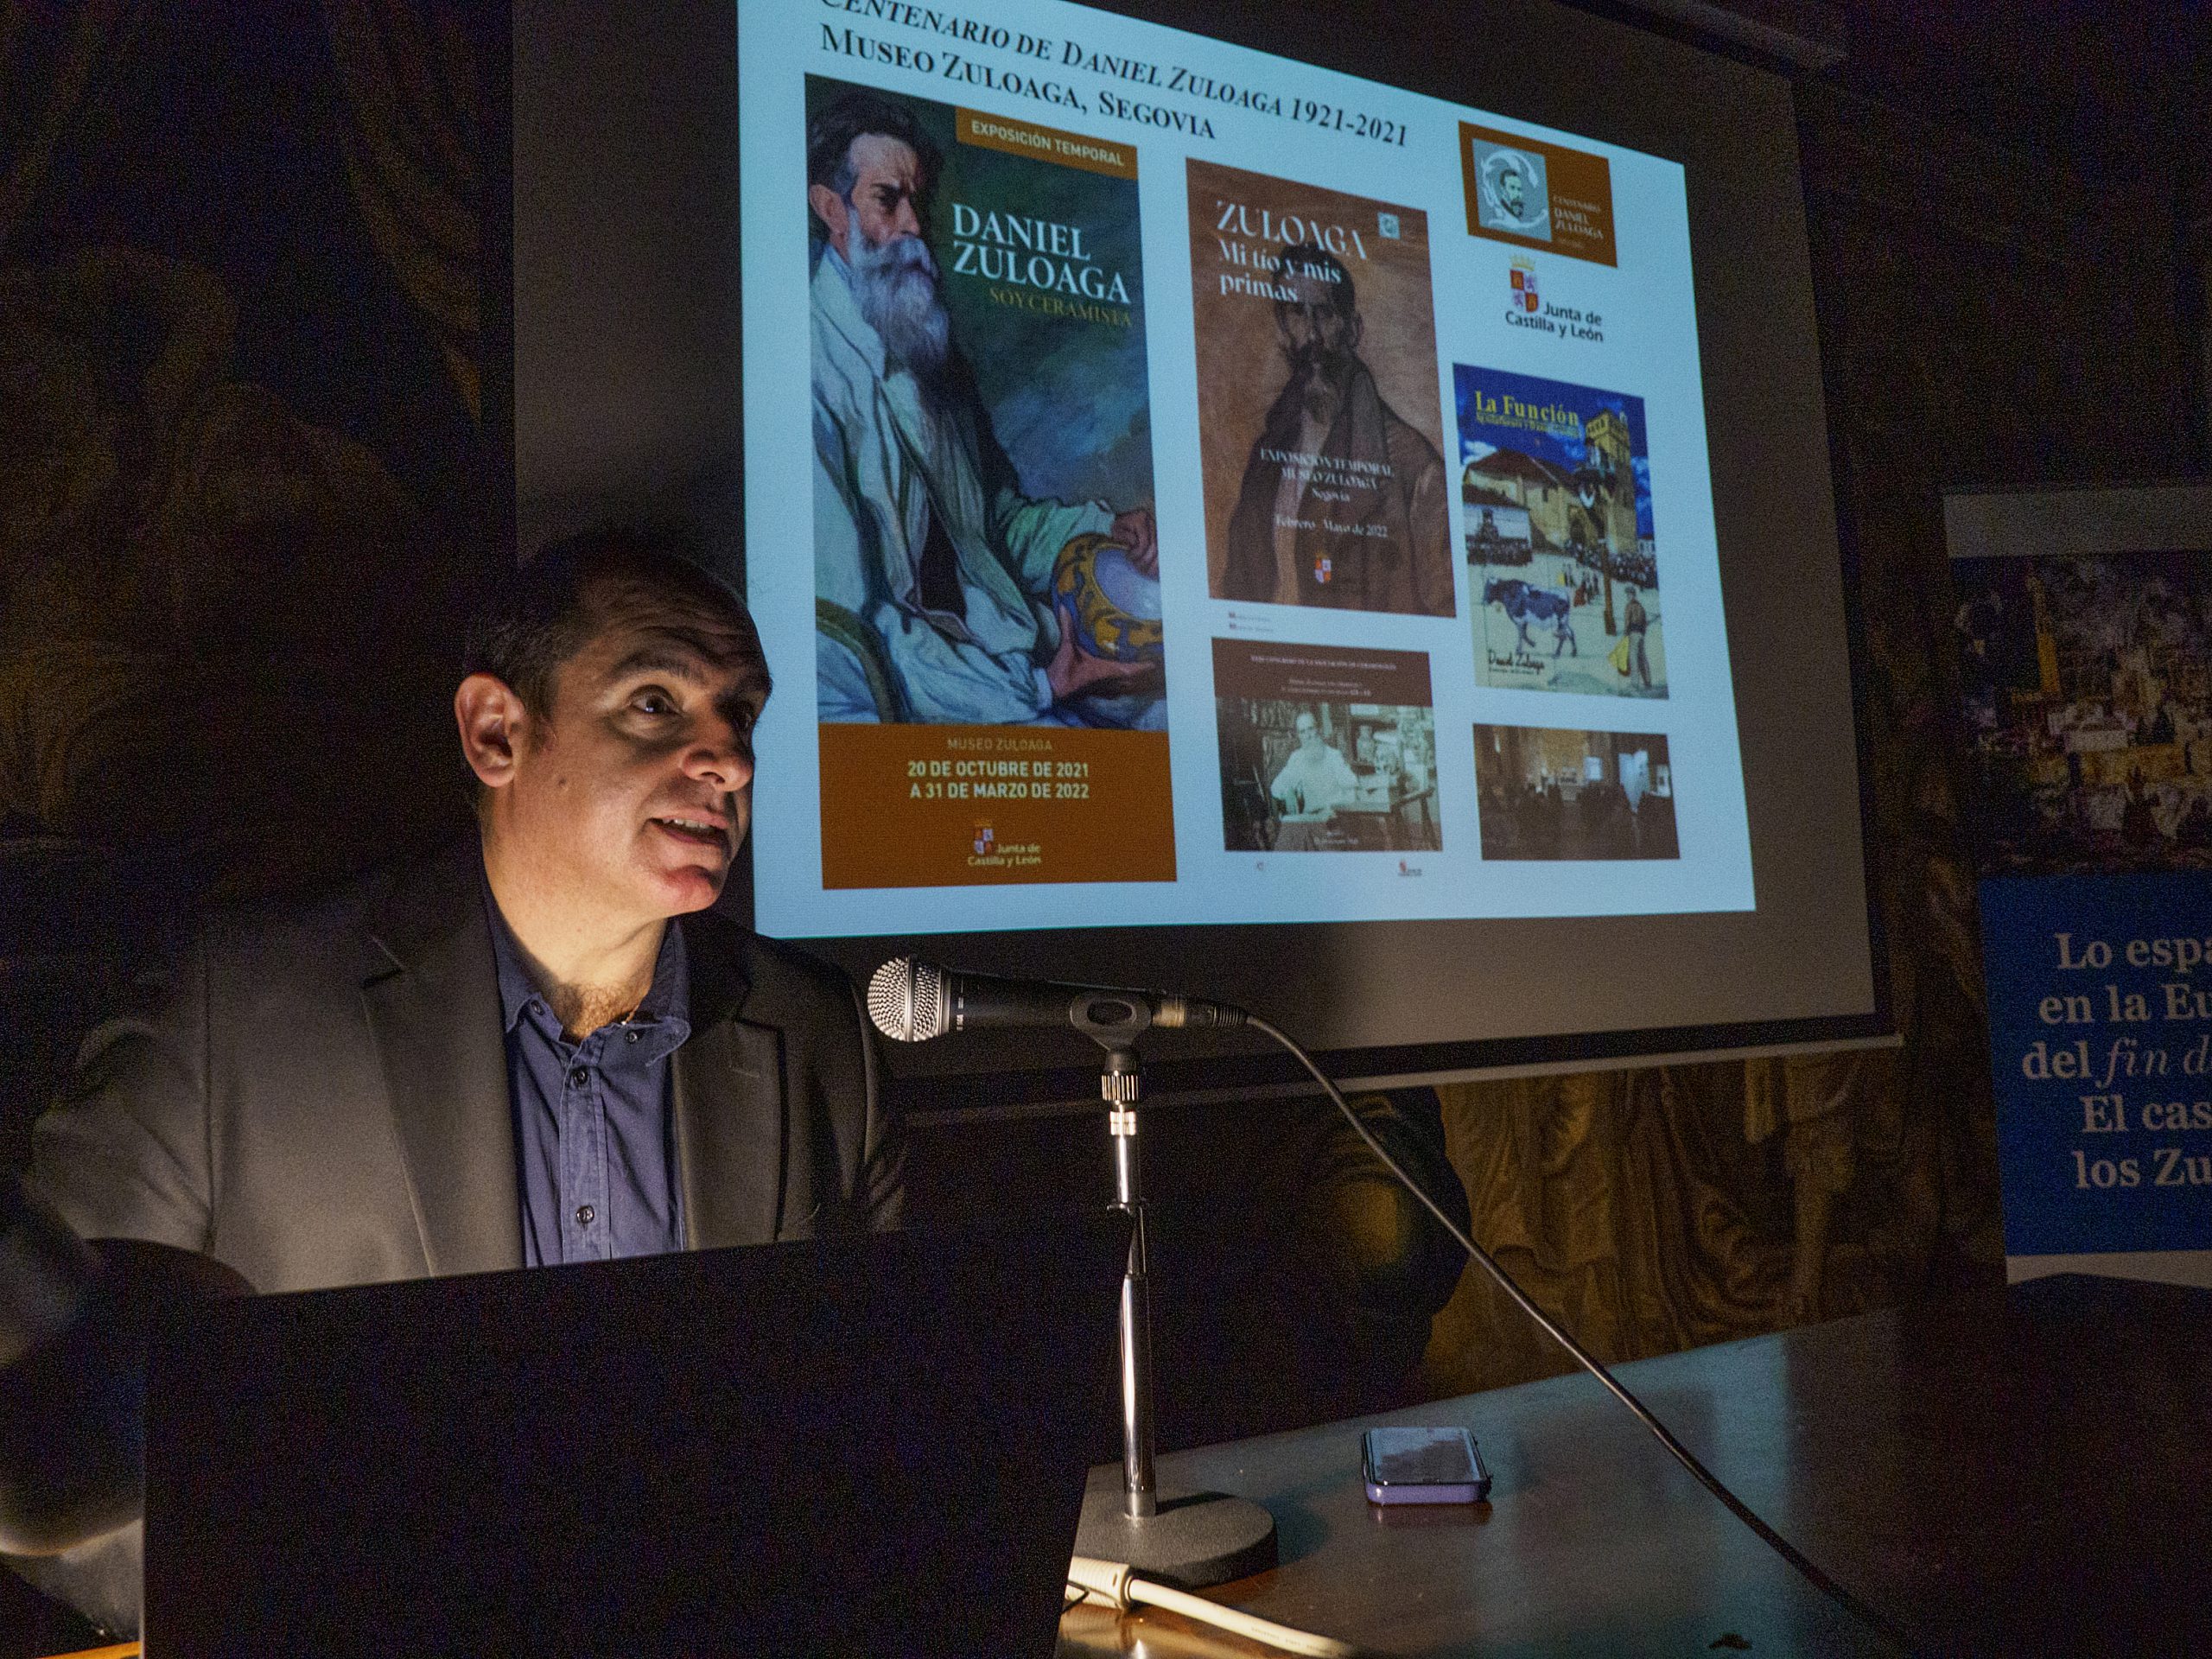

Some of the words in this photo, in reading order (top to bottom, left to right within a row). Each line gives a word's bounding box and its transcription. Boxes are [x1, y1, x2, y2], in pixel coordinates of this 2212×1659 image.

[821, 22, 934, 73] MUSEO
[943, 52, 1088, 112] ZULOAGA,
[1099, 91, 1217, 139] SEGOVIA
[822, 0, 1009, 49] ENTENARIO
[1016, 34, 1051, 61] DE
[1061, 39, 1162, 87] DANIEL
[1168, 66, 1282, 117] ZULOAGA
[1293, 97, 1408, 147] 1921-2021
[971, 120, 1052, 150] EXPOSICIÓN
[1055, 138, 1125, 167] TEMPORAL
[953, 202, 1091, 261] DANIEL
[1217, 200, 1367, 260] ZULOAGA
[953, 240, 1131, 305] ZULOAGA
[1219, 238, 1246, 265] Mi
[1304, 261, 1341, 283] mis
[989, 287, 1023, 308] SOY
[1028, 295, 1133, 328] CERAMISTA
[1220, 273, 1298, 302] primas
[1505, 310, 1555, 334] Castilla
[1559, 323, 1567, 340] y
[1571, 322, 1604, 342] León
[1543, 302, 1581, 323] Junta
[1586, 310, 1602, 327] de
[1475, 390, 1497, 414] La
[1503, 394, 1579, 427] Función
[946, 737, 994, 751] MUSEO
[996, 737, 1053, 752] ZULOAGA
[908, 760, 925, 778] 20
[931, 760, 950, 777] DE
[956, 761, 1028, 778] OCTUBRE
[1033, 761, 1052, 778] DE
[1056, 761, 1089, 779] 2021
[910, 783, 922, 799] A
[925, 783, 942, 798] 31
[948, 783, 968, 798] DE
[973, 783, 1027, 799] MARZO
[1032, 783, 1052, 798] DE
[1056, 783, 1090, 799] 2022
[2054, 932, 2113, 969] Lo
[2038, 995, 2094, 1026] en
[2106, 984, 2152, 1022] la
[2022, 1039, 2092, 1080] del
[2095, 1037, 2170, 1089] fin
[2079, 1094, 2129, 1134] El
[2141, 1101, 2212, 1132] cas
[2071, 1150, 2141, 1189] los
[2152, 1148, 2212, 1186] Zu
